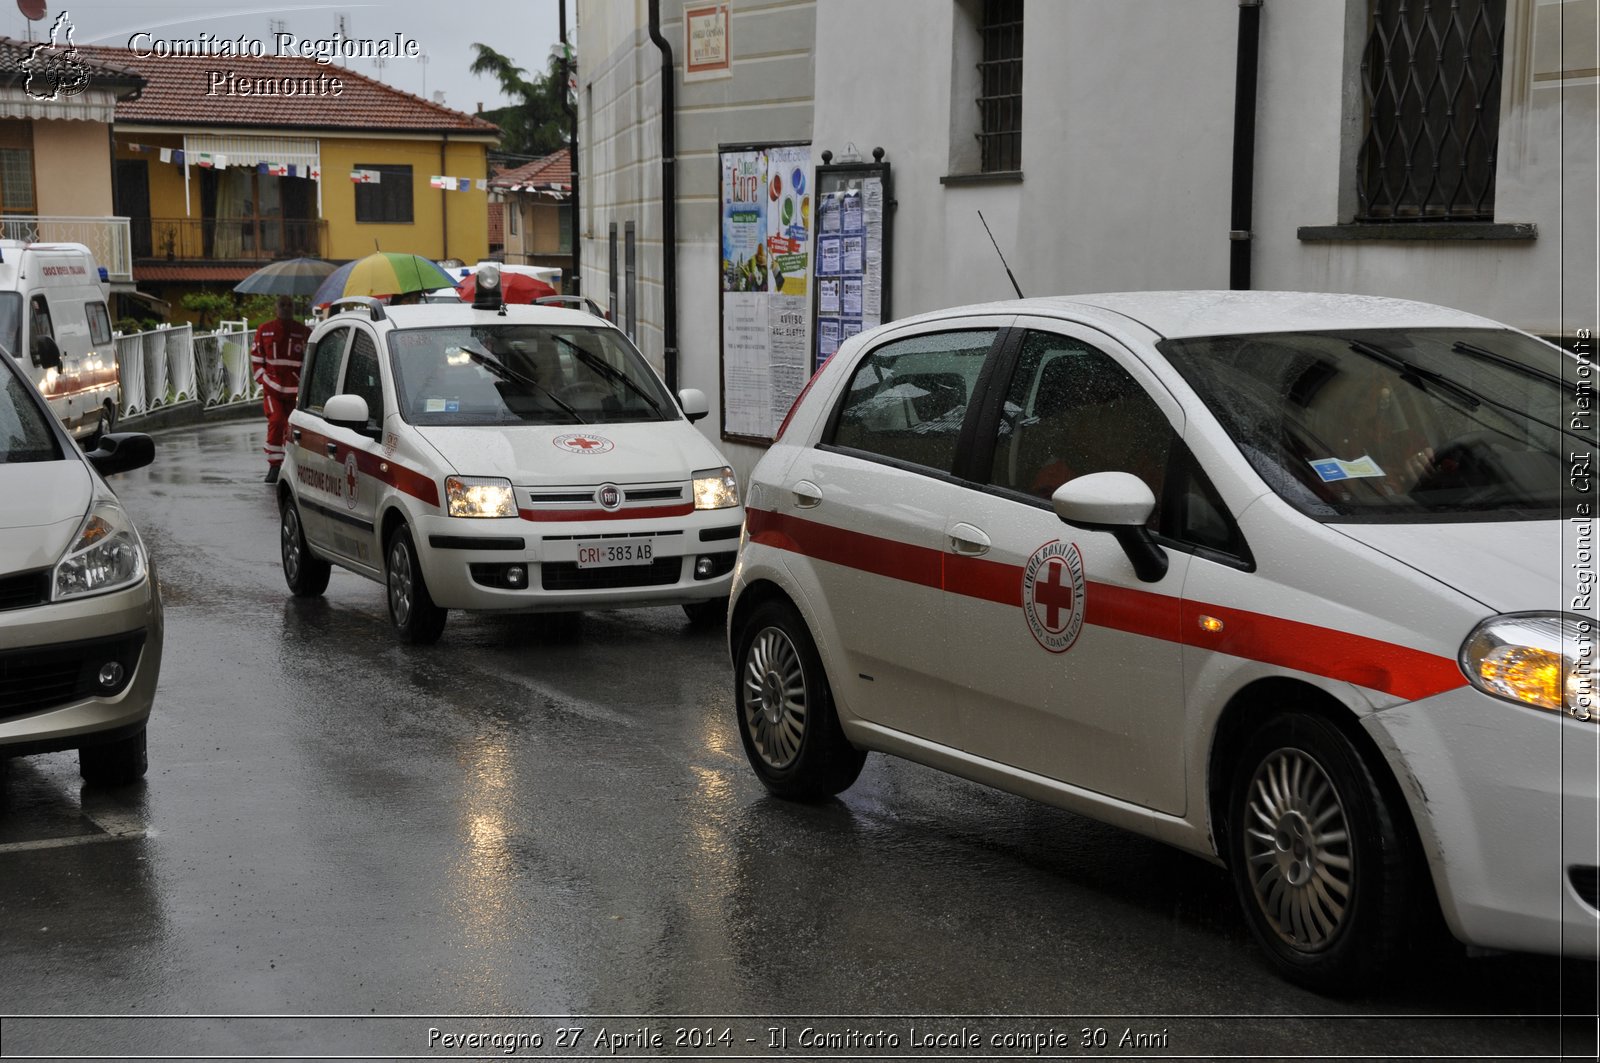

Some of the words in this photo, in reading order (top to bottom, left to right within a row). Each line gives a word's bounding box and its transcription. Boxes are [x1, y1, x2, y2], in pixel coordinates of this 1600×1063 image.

[780, 314, 803, 325] AVVISO
[297, 464, 325, 491] PROTEZIONE
[325, 473, 342, 497] CIVILE
[579, 547, 600, 563] CRI
[607, 545, 632, 561] 383
[637, 544, 652, 560] AB
[1025, 553, 1042, 589] CROCE
[1042, 543, 1068, 560] ROSSA
[1026, 601, 1043, 638] BORGO
